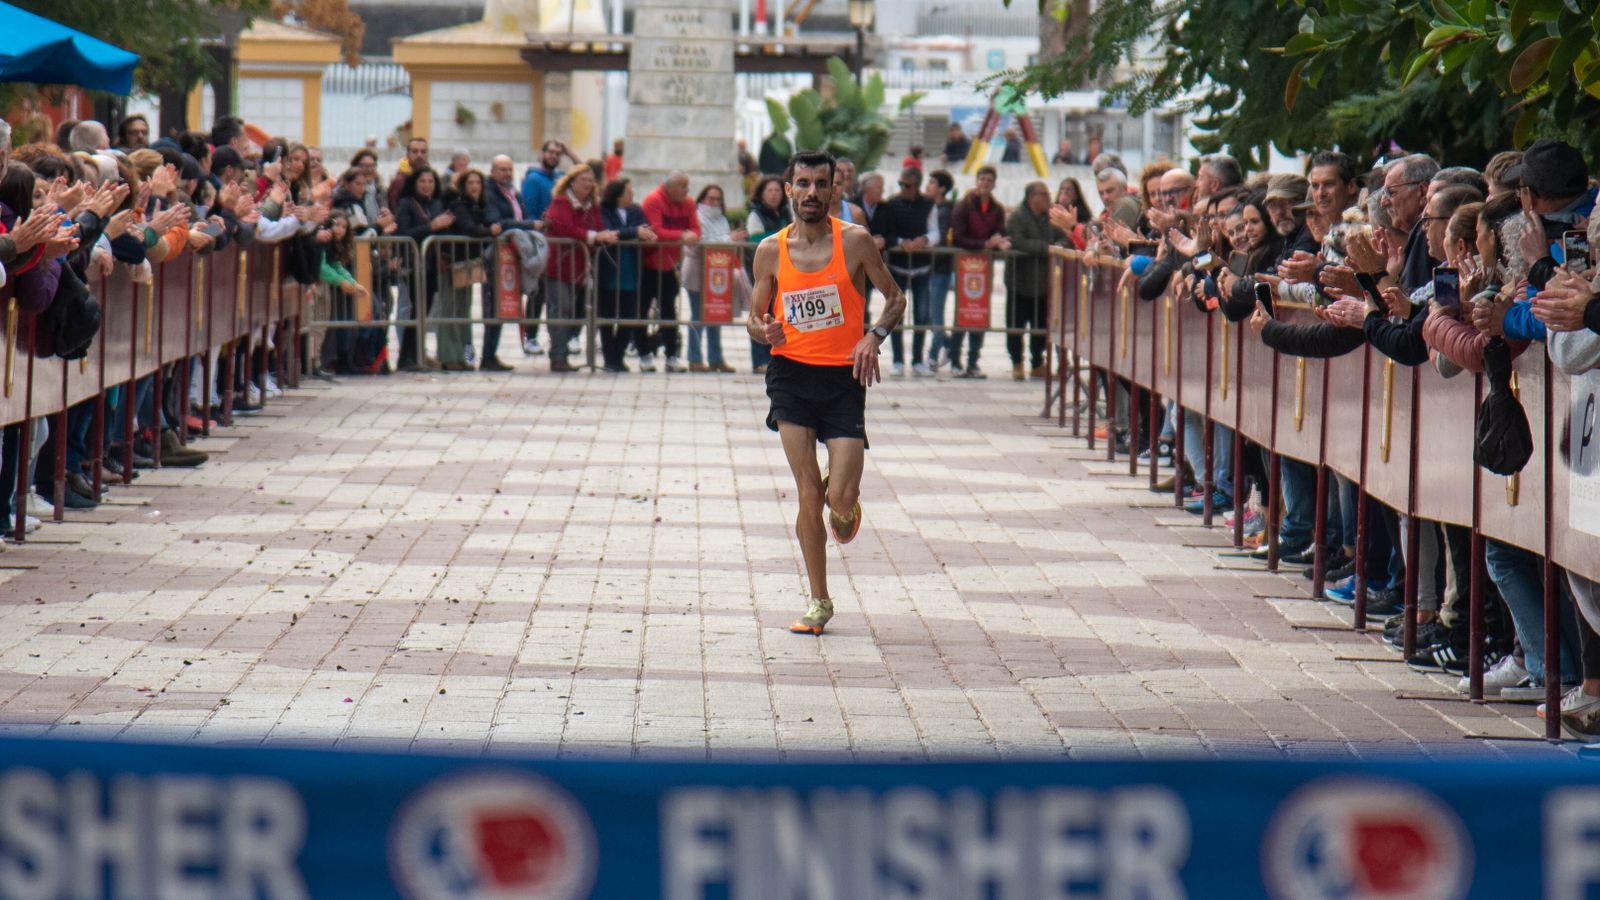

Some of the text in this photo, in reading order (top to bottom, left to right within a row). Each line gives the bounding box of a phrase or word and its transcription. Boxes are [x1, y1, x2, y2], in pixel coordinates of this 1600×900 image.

[790, 293, 806, 303] XIV
[797, 299, 826, 318] 199
[662, 788, 1193, 900] FINISHER
